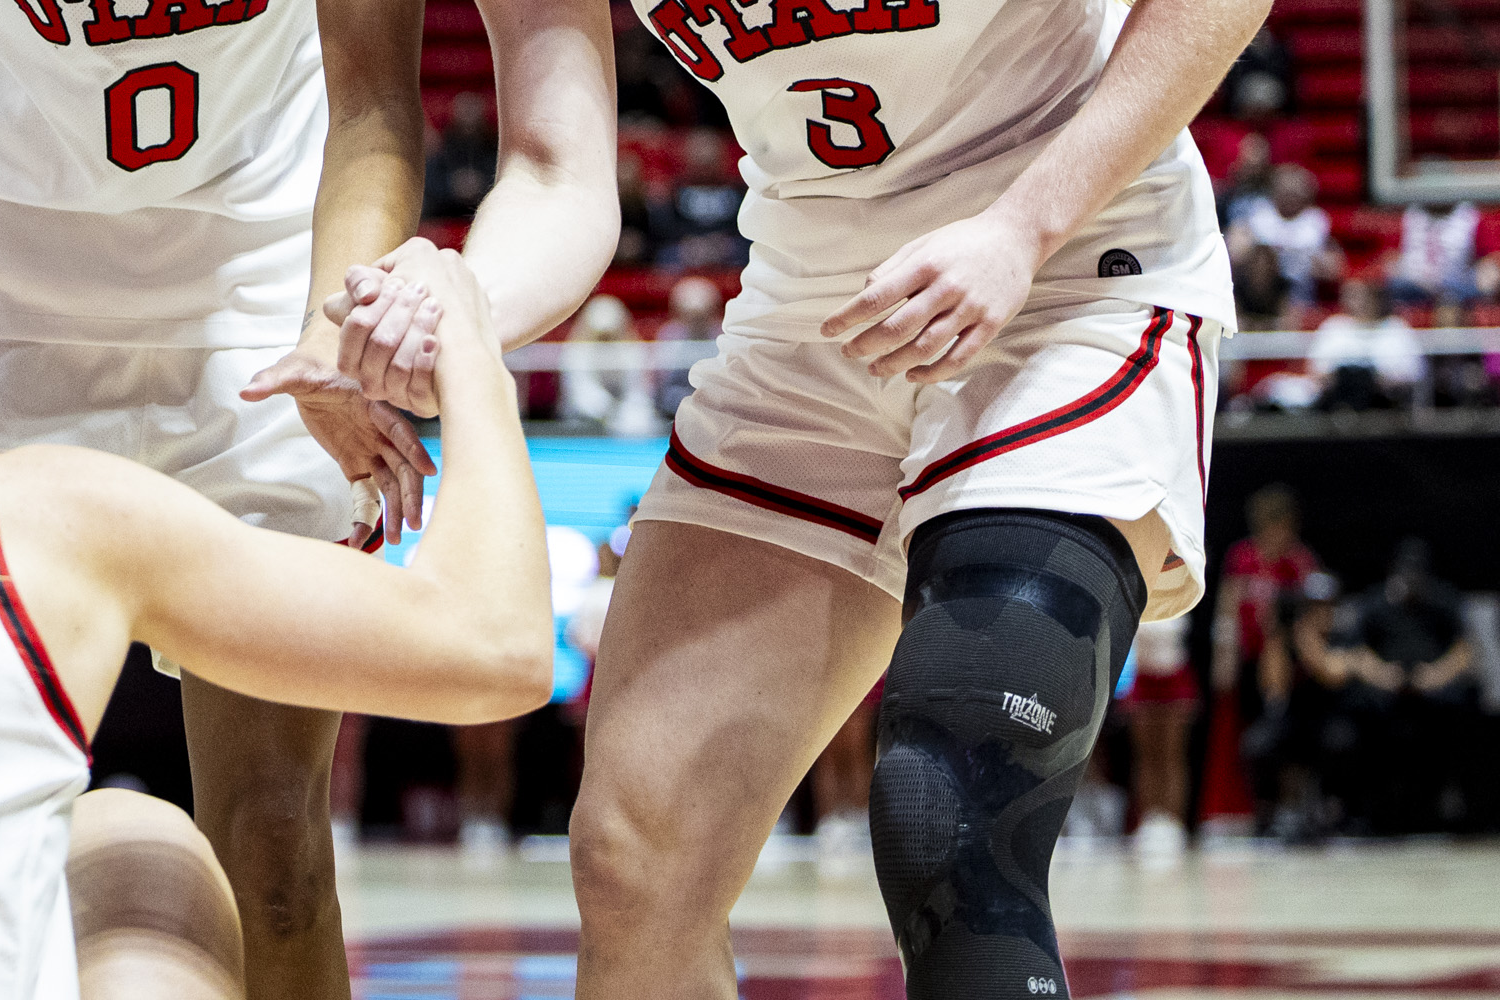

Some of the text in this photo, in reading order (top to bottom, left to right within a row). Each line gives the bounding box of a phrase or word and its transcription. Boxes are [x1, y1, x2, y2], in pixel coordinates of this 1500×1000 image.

[104, 60, 199, 172] 0
[786, 77, 896, 170] 3
[1002, 691, 1057, 735] TRIZONE
